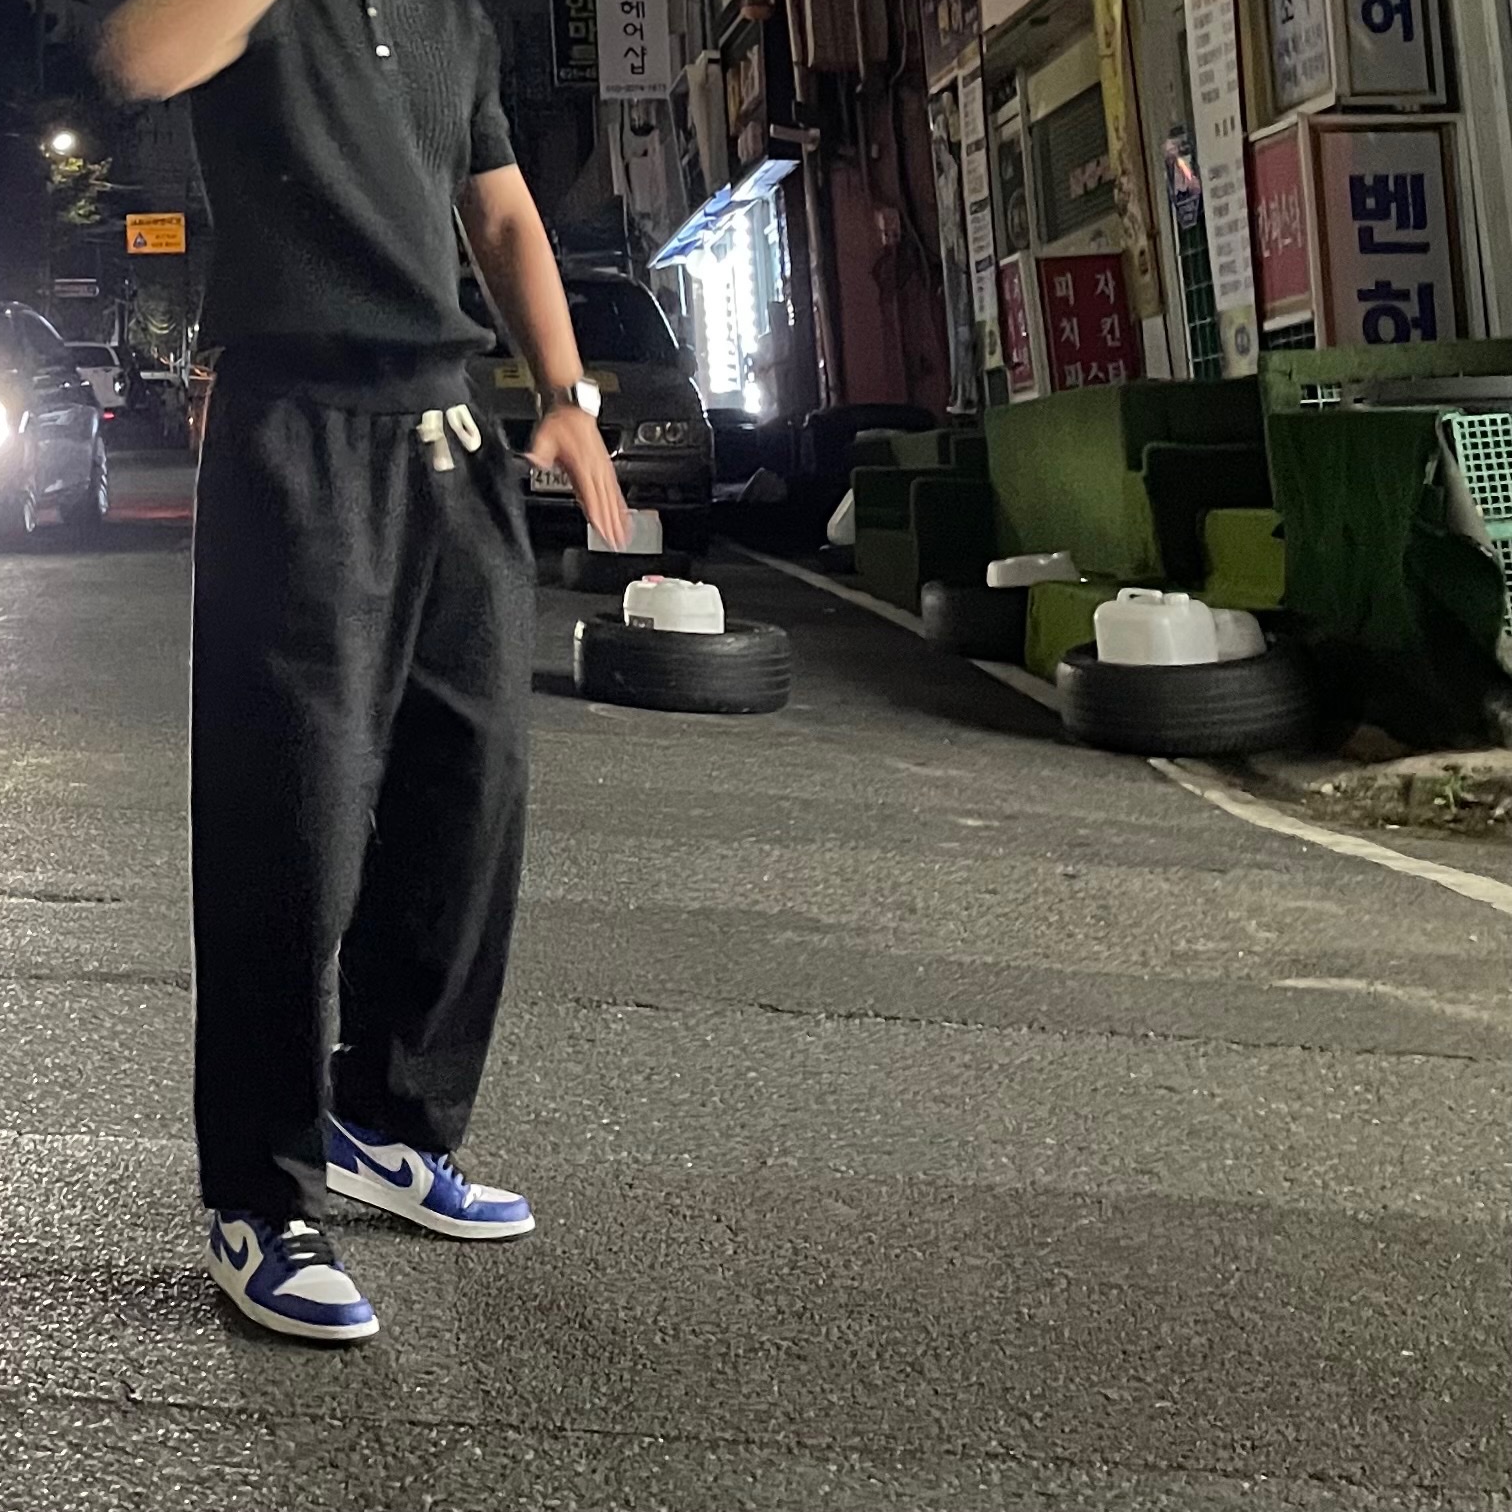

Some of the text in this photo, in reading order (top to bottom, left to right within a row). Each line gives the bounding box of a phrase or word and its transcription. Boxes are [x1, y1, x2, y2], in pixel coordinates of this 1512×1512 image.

[1349, 172, 1438, 344] 벤허
[1054, 270, 1116, 307] 피자
[1060, 313, 1122, 351] 치킨
